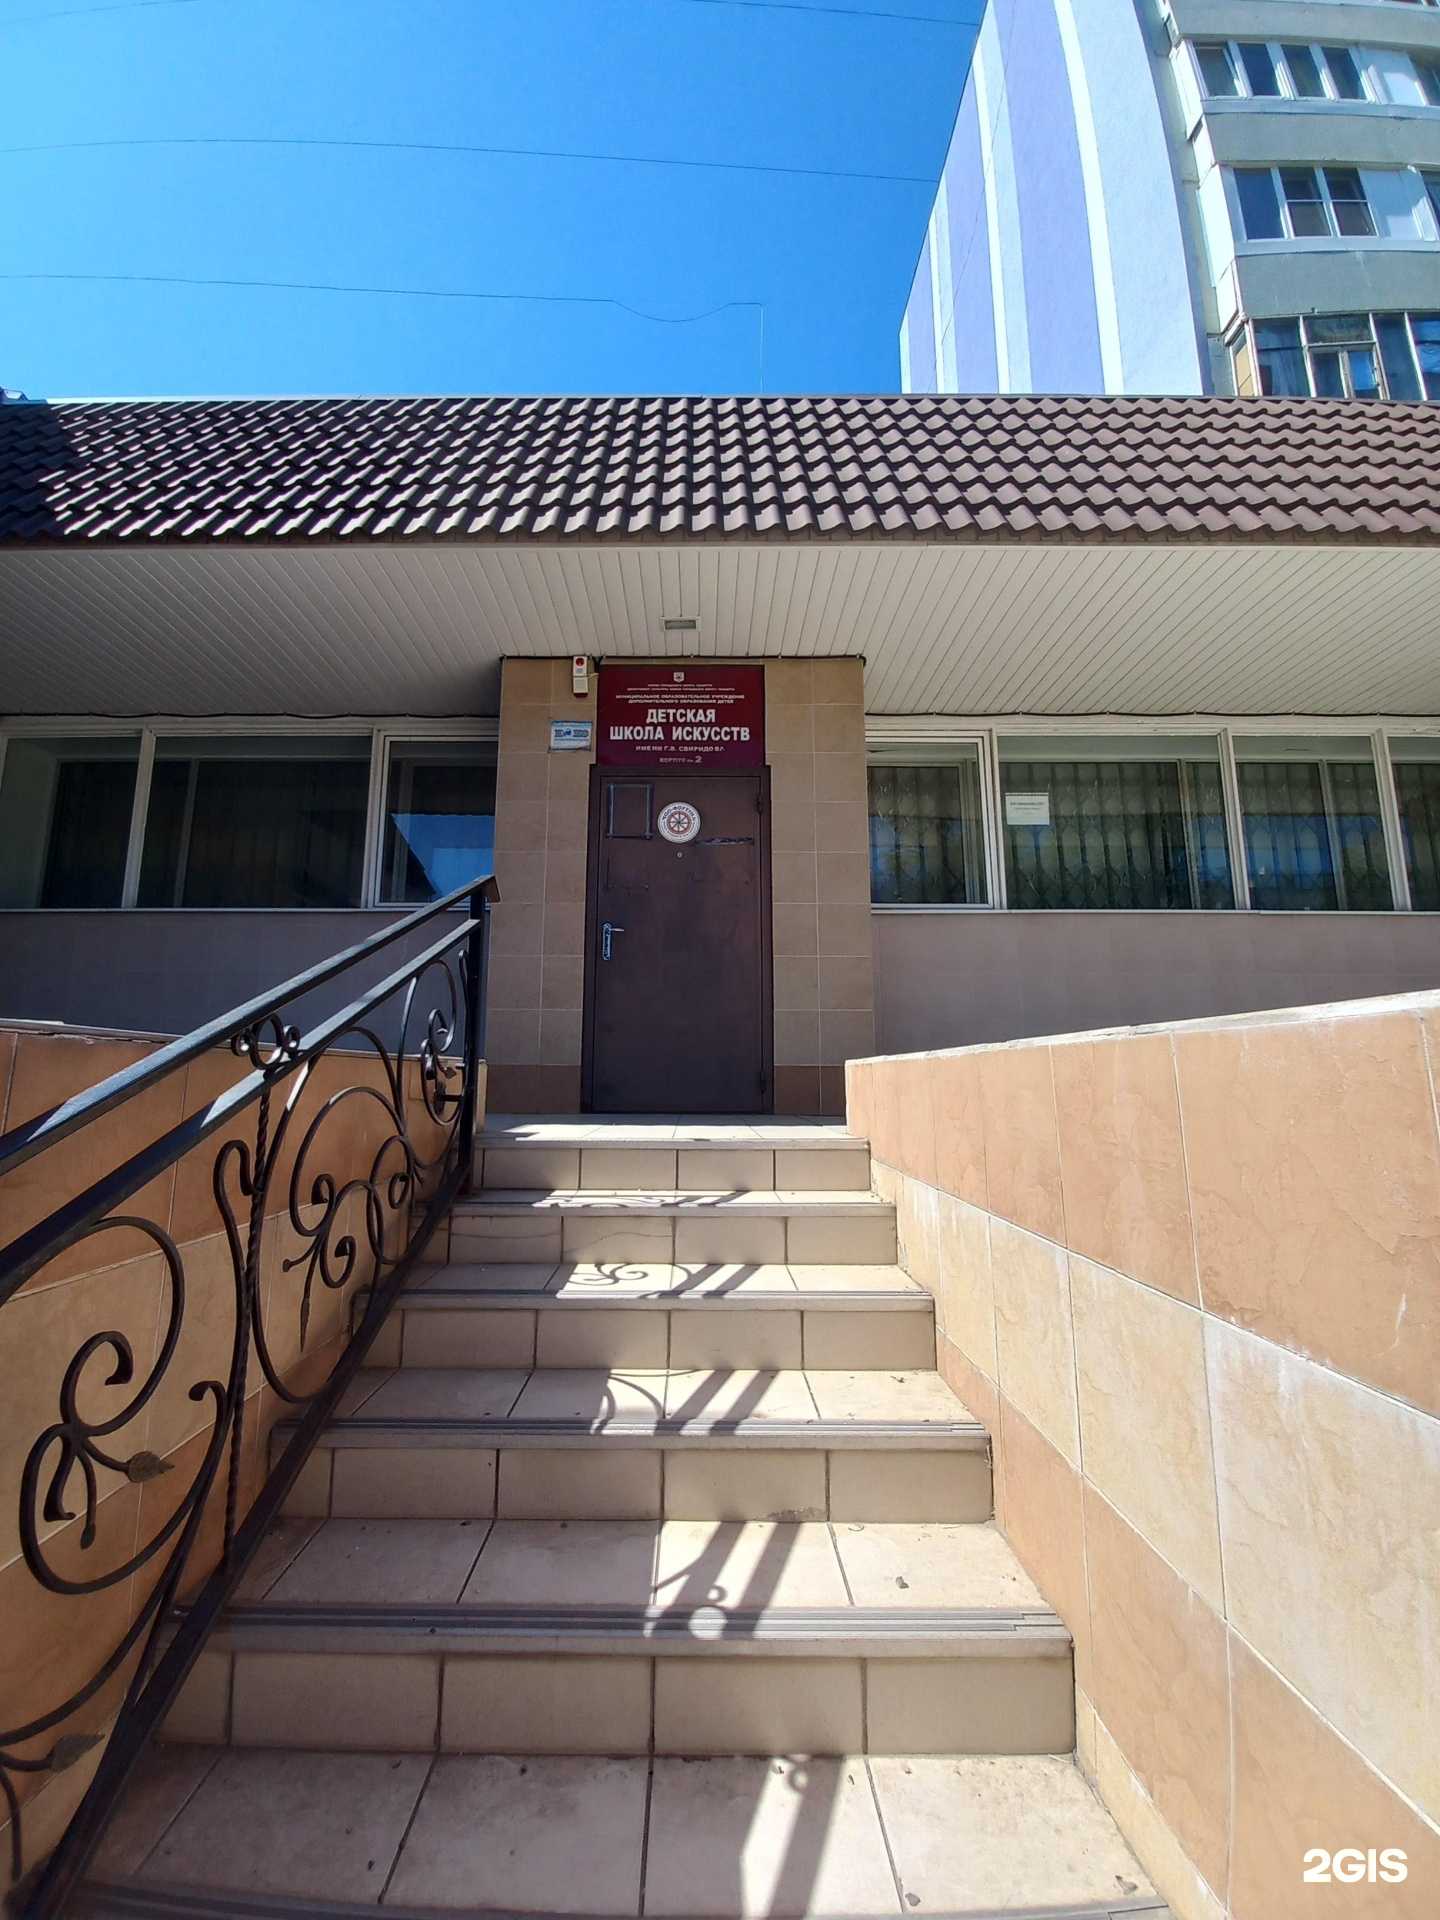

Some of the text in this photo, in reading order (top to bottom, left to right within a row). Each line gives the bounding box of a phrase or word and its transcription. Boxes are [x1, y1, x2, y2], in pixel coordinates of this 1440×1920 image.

[646, 708, 716, 724] ДЕТСКАЯ
[609, 726, 750, 741] ШКОЛА ИСКУССТВ
